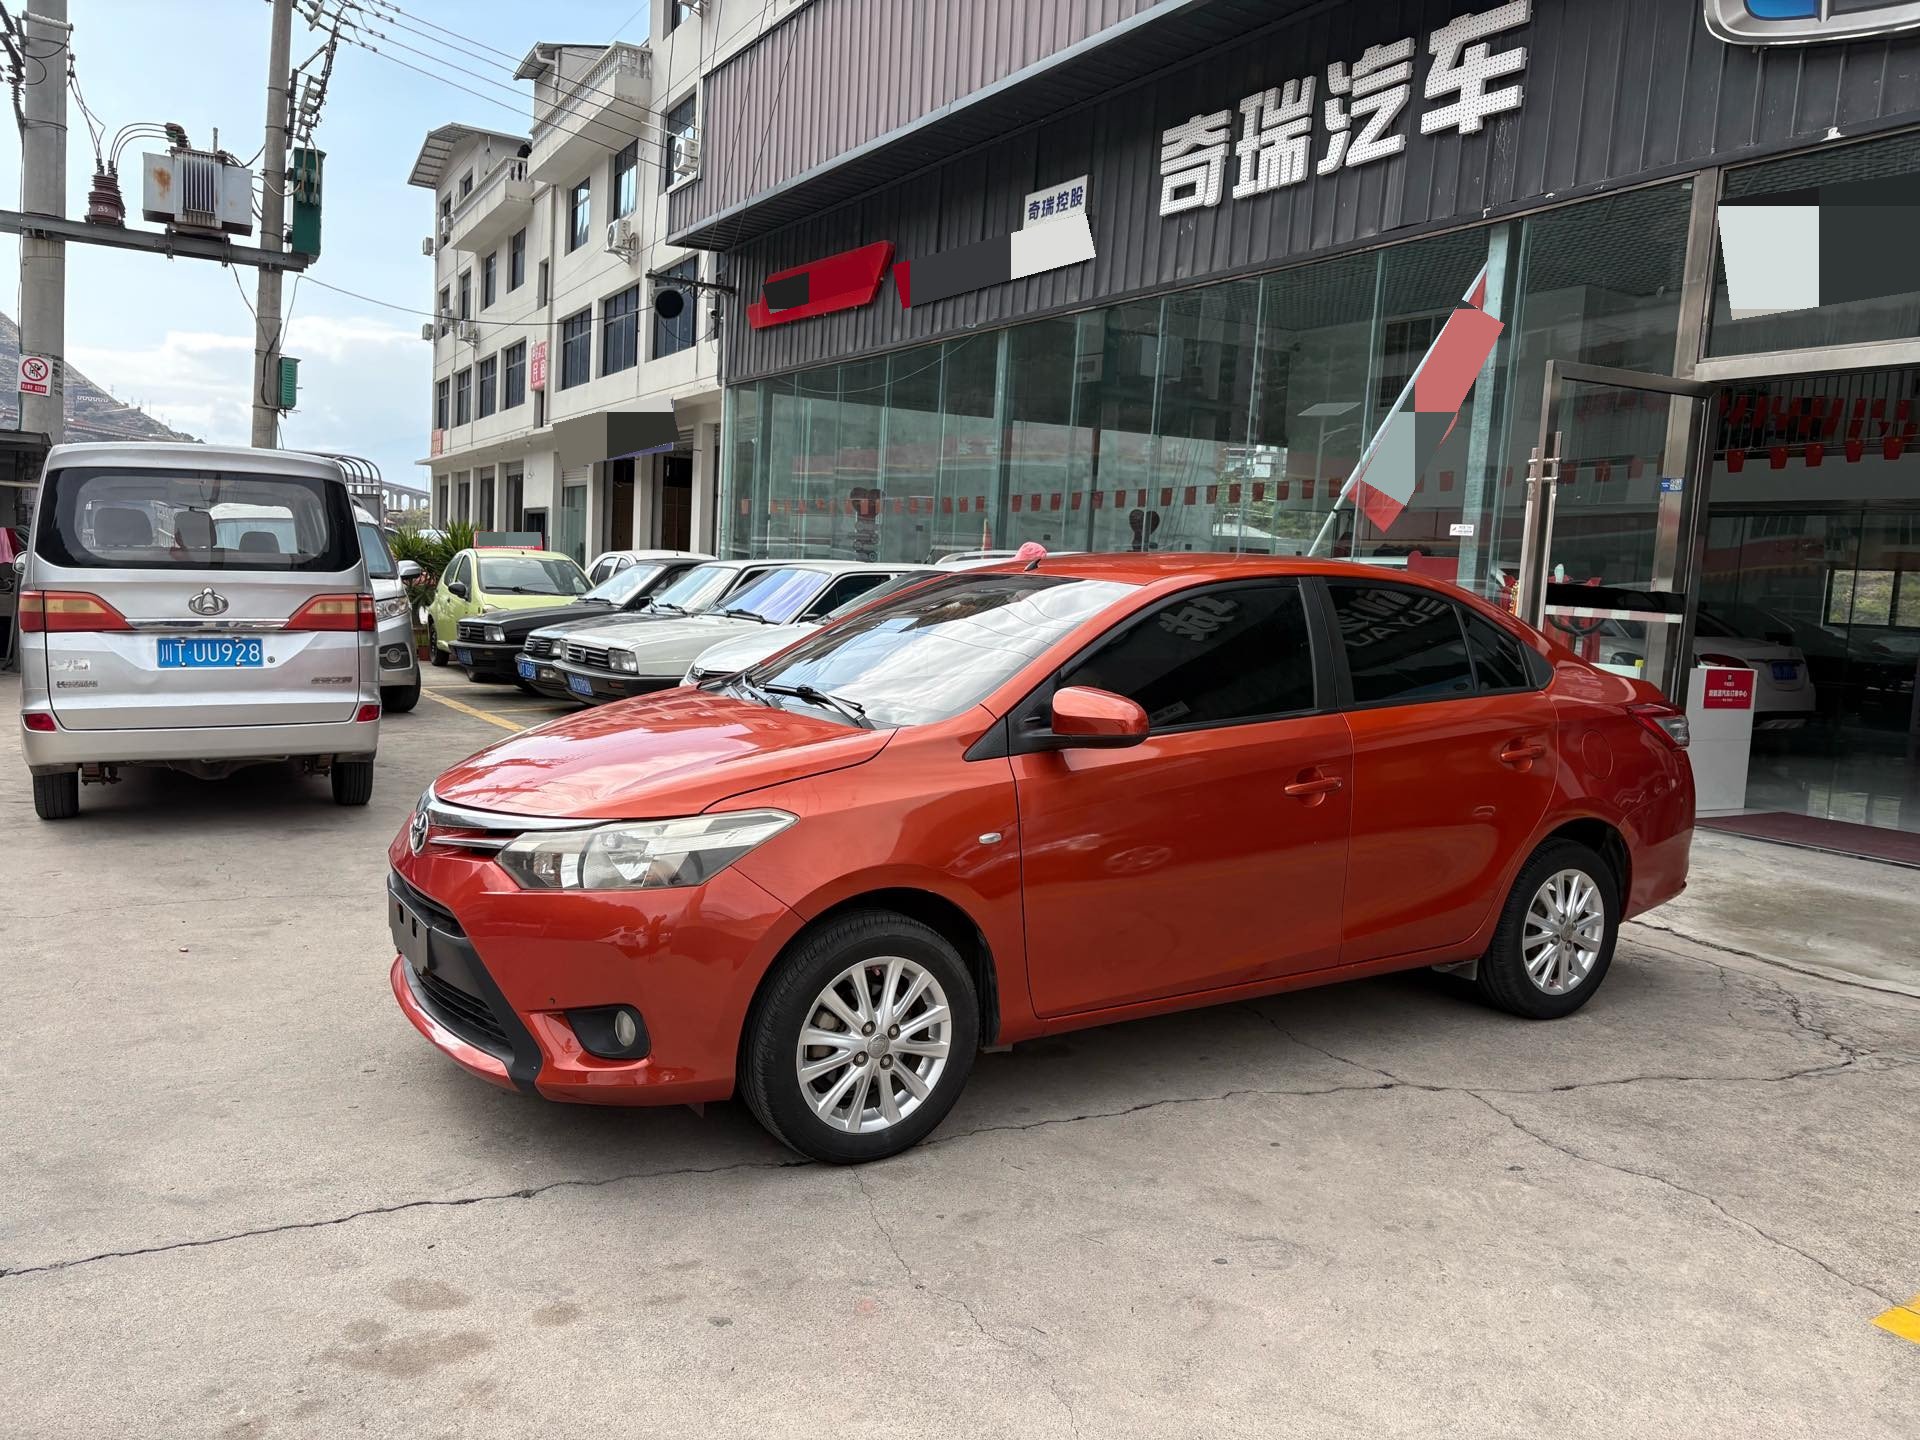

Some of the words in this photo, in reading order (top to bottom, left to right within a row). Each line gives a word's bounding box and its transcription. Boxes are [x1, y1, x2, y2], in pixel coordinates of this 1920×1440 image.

[1159, 0, 1533, 217] 奇瑞汽车
[1028, 185, 1084, 221] 奇瑞控股
